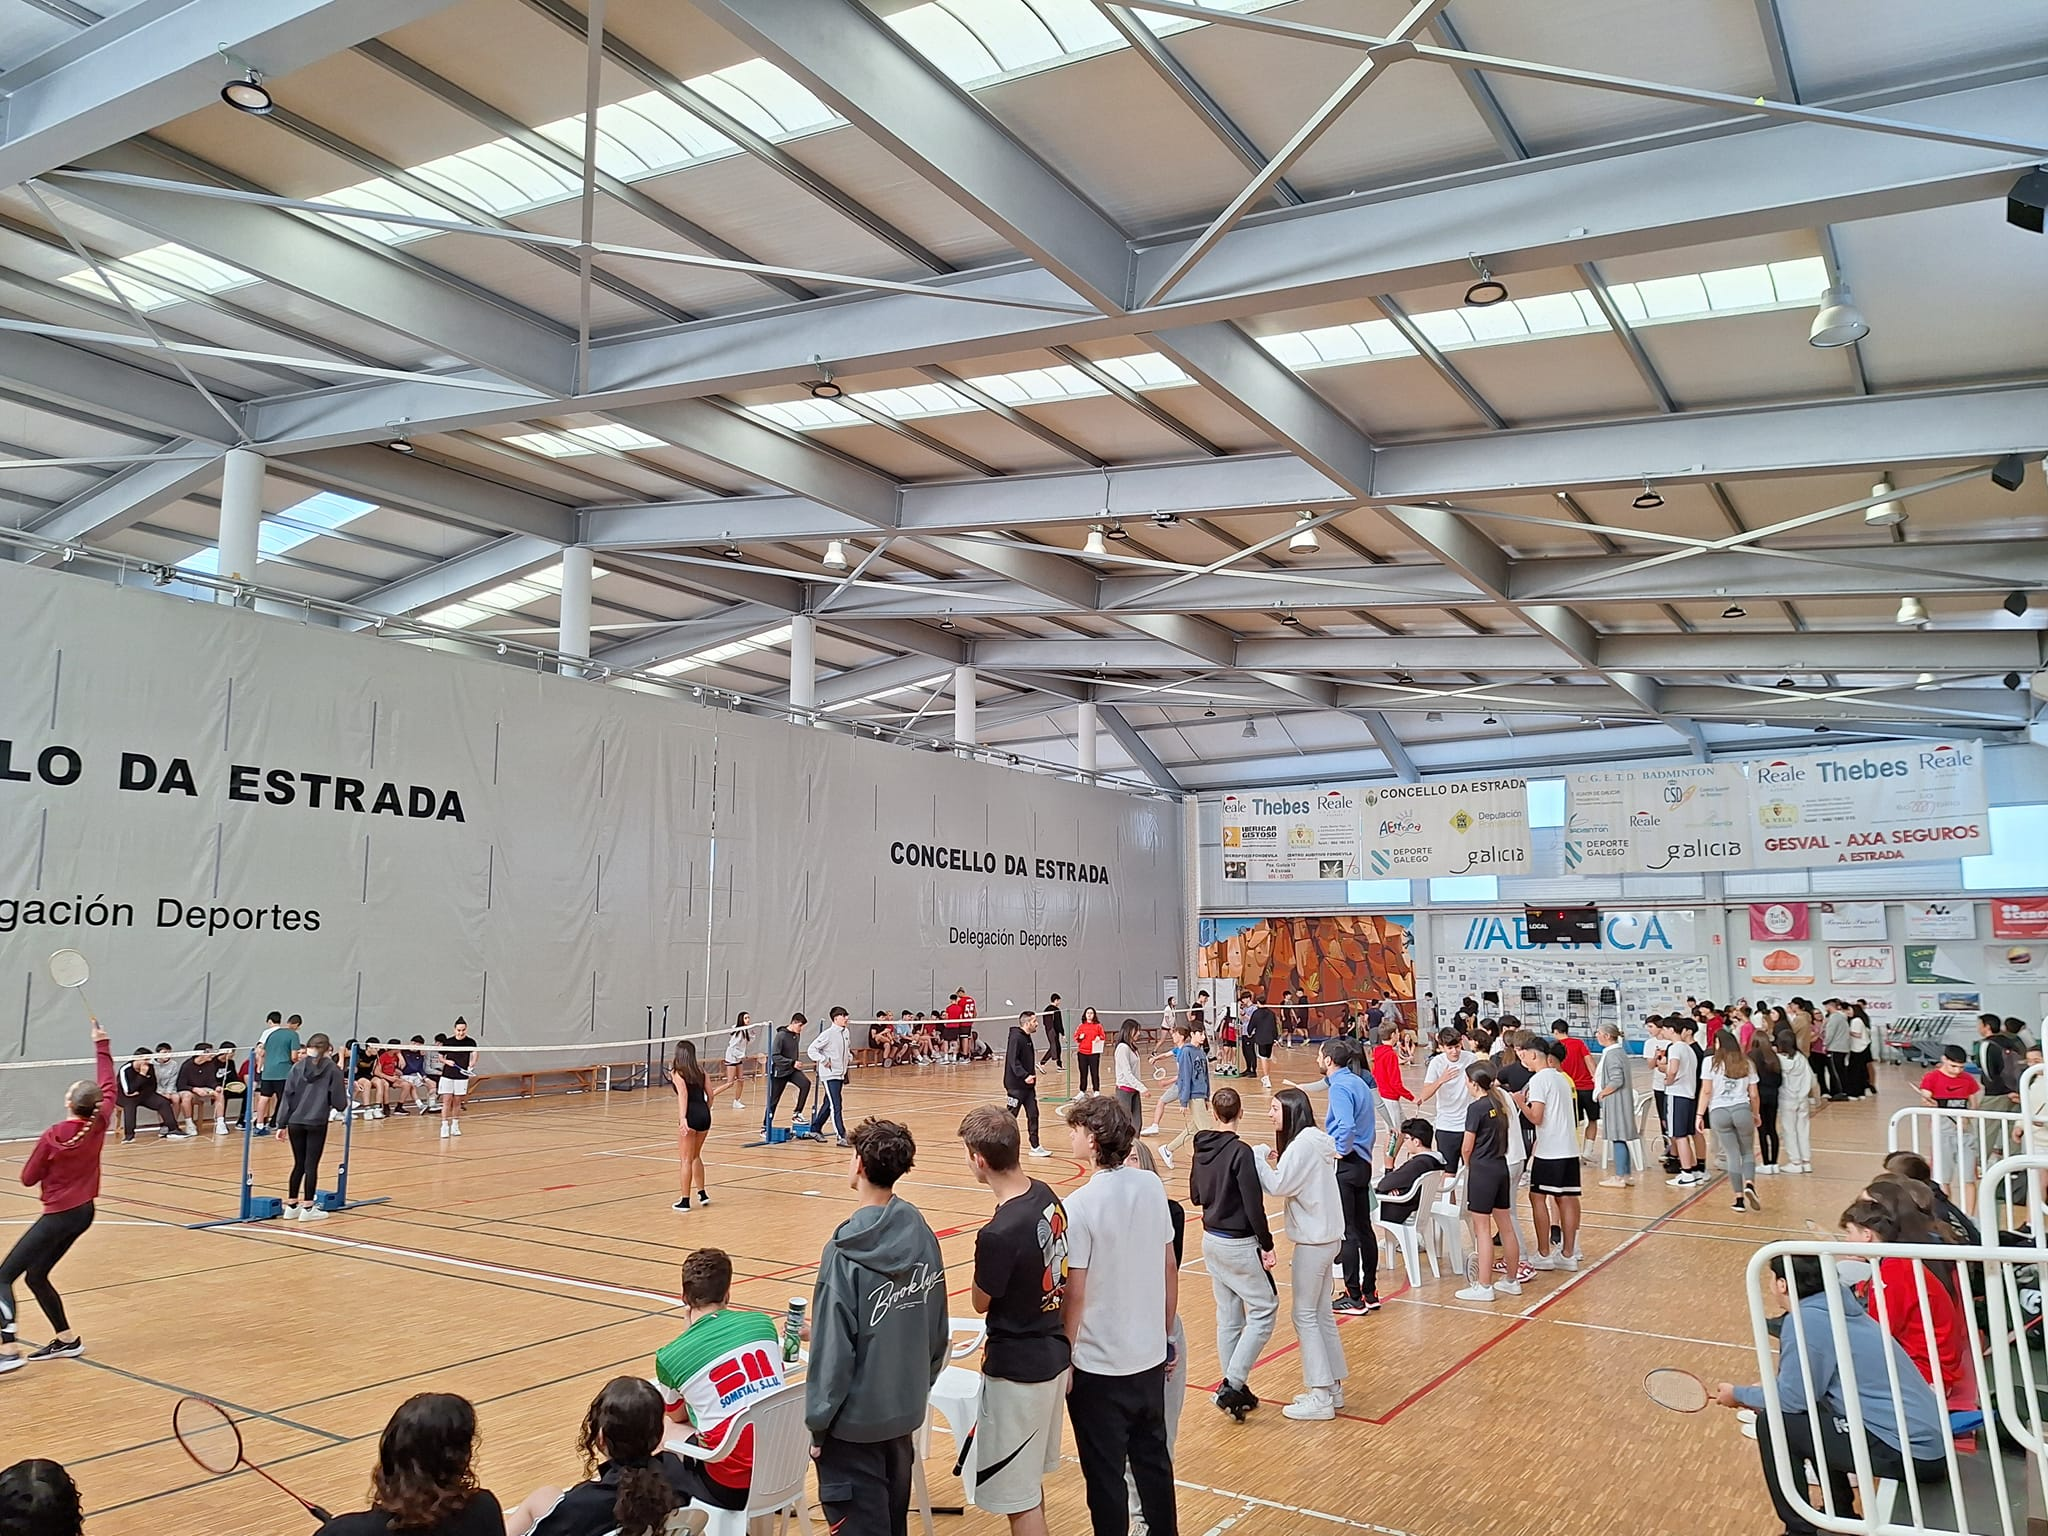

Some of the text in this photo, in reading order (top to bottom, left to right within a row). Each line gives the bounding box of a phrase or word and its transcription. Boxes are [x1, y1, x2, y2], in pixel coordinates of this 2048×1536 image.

[1920, 750, 1973, 770] Reale
[1642, 767, 1715, 780] BADMINTON
[1757, 765, 1806, 784] Reale
[1816, 758, 1909, 783] Thebes
[119, 752, 198, 797] DA
[228, 764, 466, 823] ESTRADA
[1380, 779, 1526, 799] CONCELLO DA ESTRADA
[1664, 787, 1682, 803] CSD
[1252, 798, 1310, 815] Thebes
[1317, 795, 1353, 810] Reale
[1478, 810, 1522, 821] Deputación
[1630, 815, 1661, 827] Reale
[1587, 840, 1629, 848] DEPORTE
[1765, 836, 1830, 852] GESVAL
[1847, 832, 1887, 847] AXA
[1892, 825, 1980, 844] SEGUROS
[1393, 847, 1433, 856] DEPORTE
[1393, 856, 1429, 864] GALEGO
[1587, 848, 1625, 857] GALEGO
[1838, 850, 1904, 863] A ESTRADA
[890, 841, 1109, 885] CONCELLO DA ESTRADA
[156, 896, 321, 937] Deportes
[949, 927, 1068, 950] Delegación Deportes
[1484, 916, 1672, 950] ABCA
[720, 1377, 781, 1409] SOMETAL, S.L.U.
